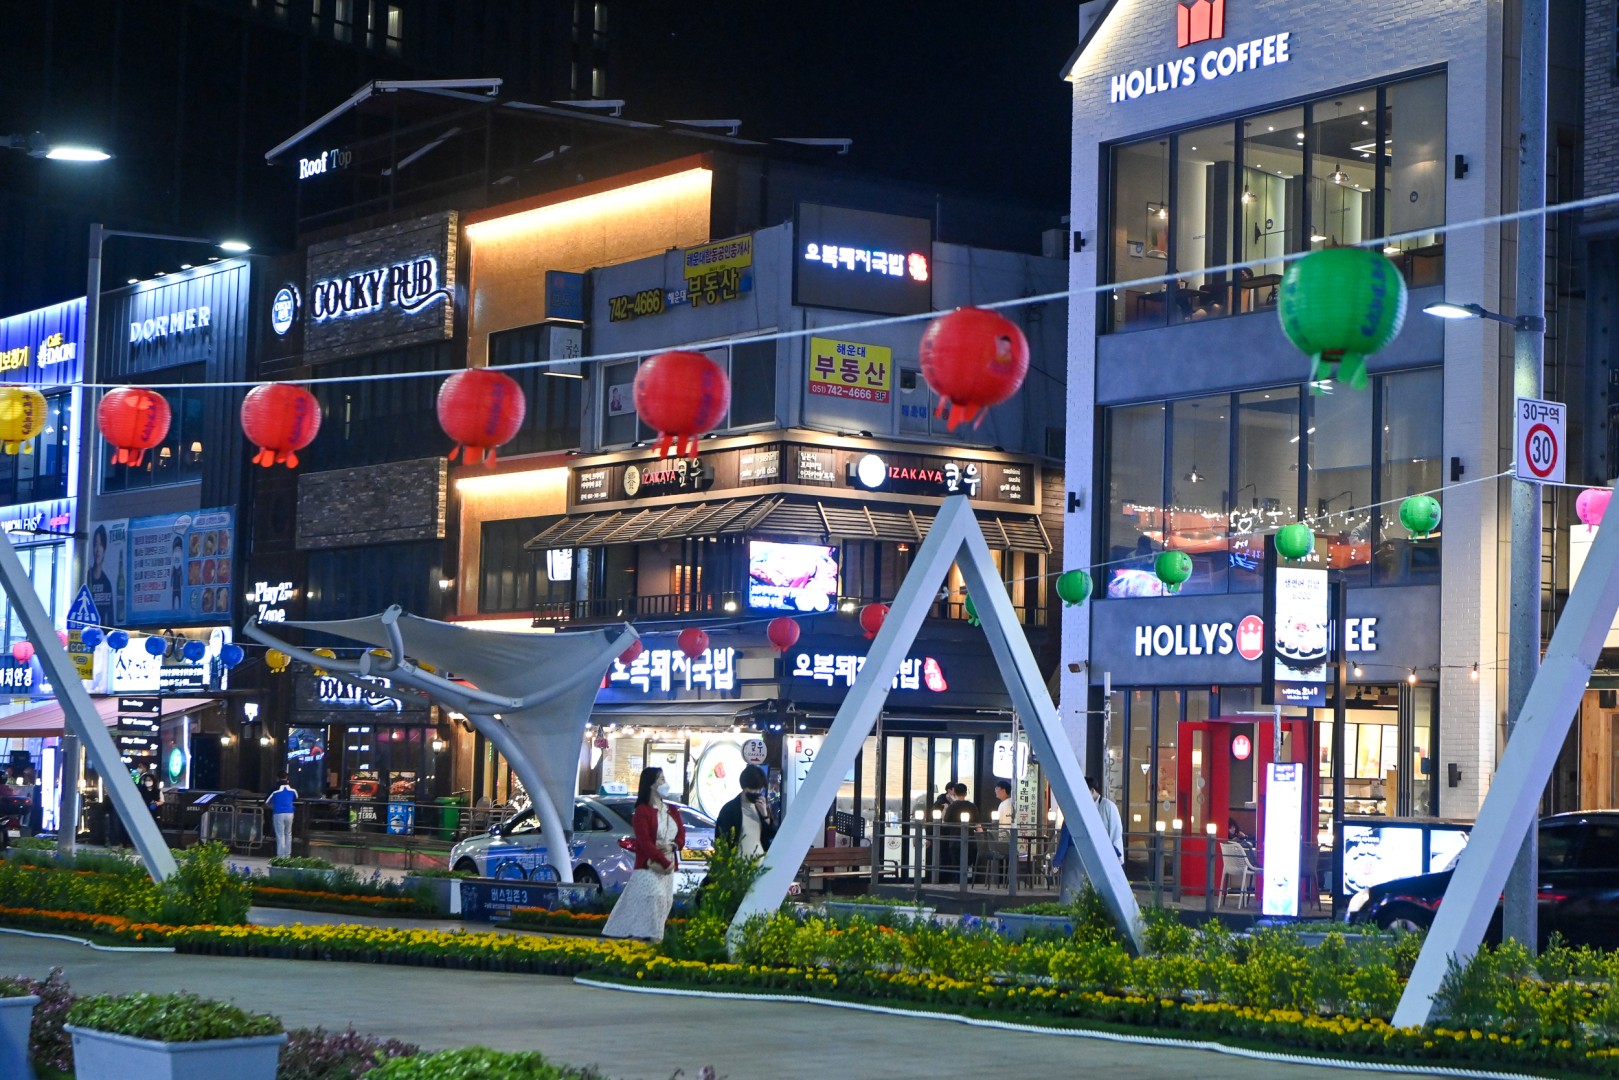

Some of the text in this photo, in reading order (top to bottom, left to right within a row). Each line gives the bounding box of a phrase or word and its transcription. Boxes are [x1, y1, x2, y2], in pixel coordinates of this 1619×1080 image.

[1110, 32, 1291, 103] HOLLYS COFFEE
[299, 148, 352, 179] Roof Top
[805, 243, 904, 276] 오복돼지국밥
[311, 259, 435, 319] COCKY PUB
[609, 267, 739, 322] 742-4666 해운대 부동산
[130, 306, 211, 343] DORMER
[0, 346, 29, 372] 보청기
[836, 343, 866, 359] 해운대
[815, 355, 886, 387] 부동산
[812, 384, 886, 400] 051) 742-4666 3F
[1523, 403, 1560, 425] 30구역
[1532, 436, 1551, 465] 30
[642, 470, 676, 485] IZAKAYA
[889, 462, 980, 496] IZAKAYA 코우
[255, 582, 279, 604] Play
[258, 604, 286, 624] Zone
[1135, 623, 1234, 657] HOLLYS
[0, 667, 33, 687] 치안경
[793, 653, 922, 691] 오복돼밥
[358, 812, 377, 820] TERRA
[521, 890, 528, 903] 3
